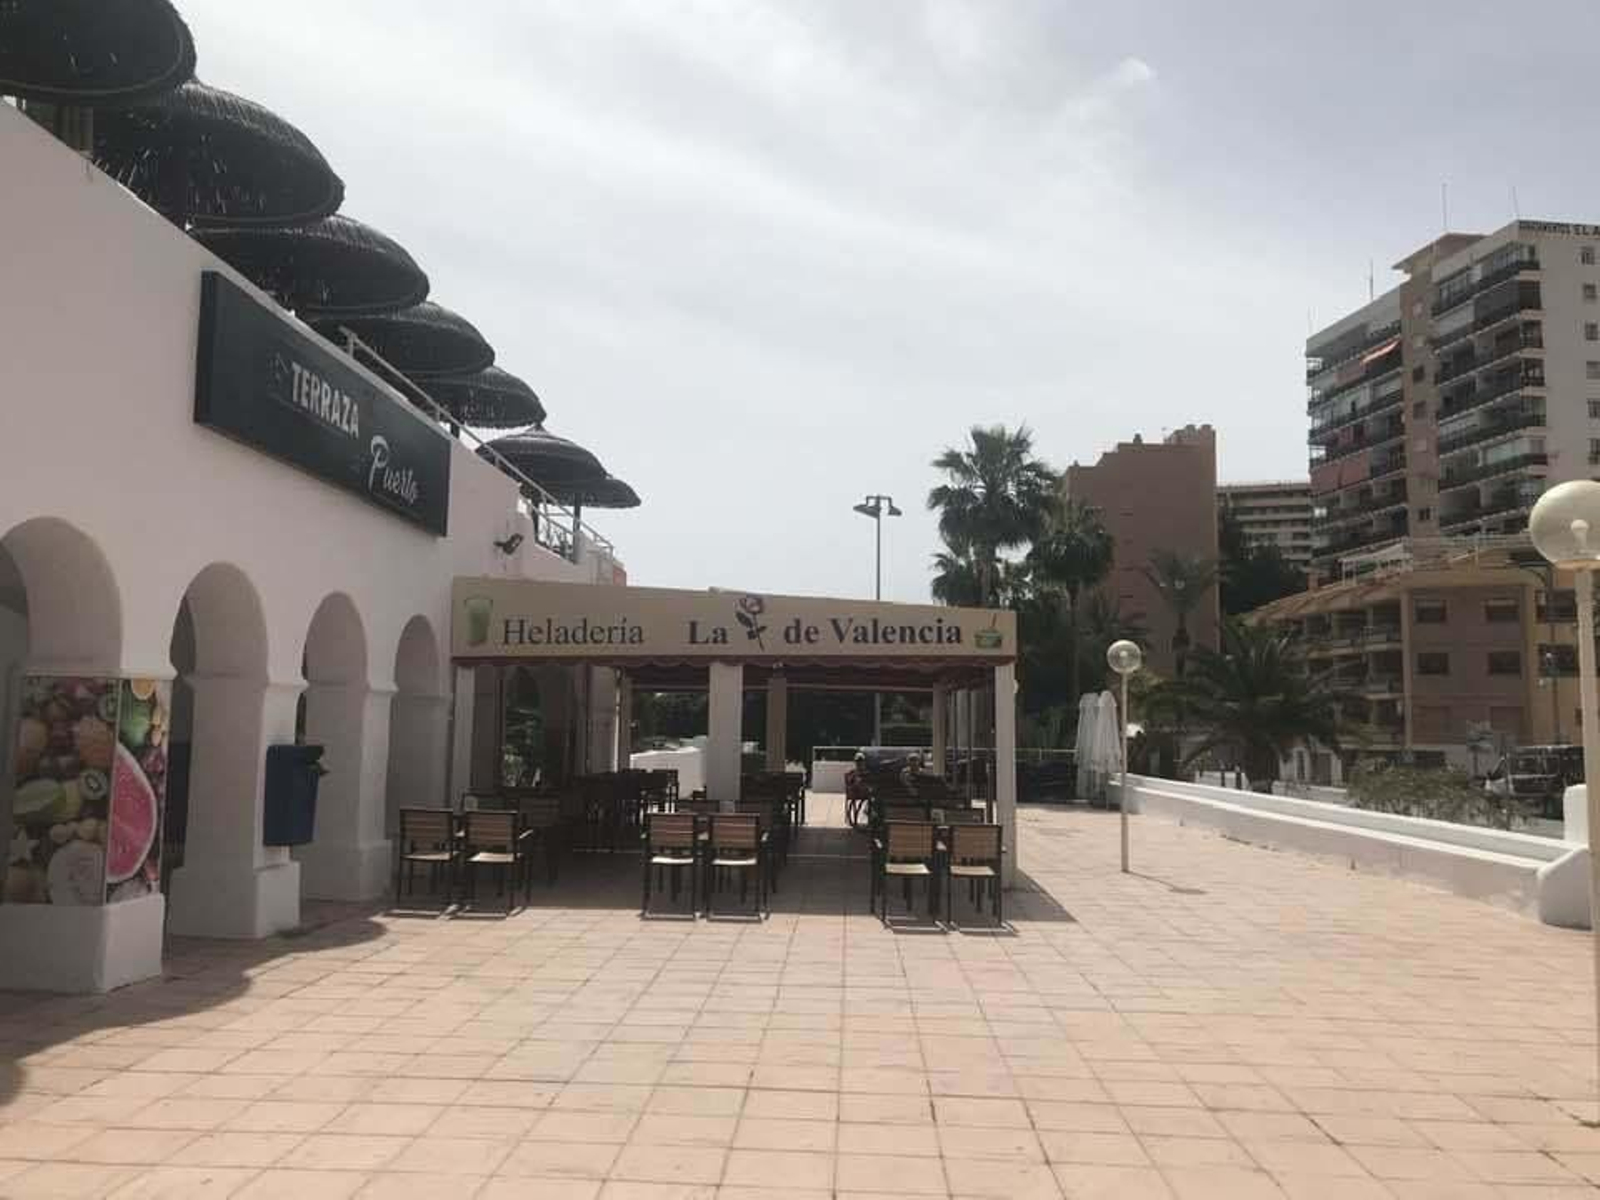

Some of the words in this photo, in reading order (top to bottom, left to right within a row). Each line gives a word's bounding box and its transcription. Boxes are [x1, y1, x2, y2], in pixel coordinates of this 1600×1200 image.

[291, 360, 360, 440] TERRAZA
[367, 434, 419, 505] Puerto
[688, 619, 729, 645] La
[783, 617, 820, 645] de
[828, 617, 962, 645] Valencia
